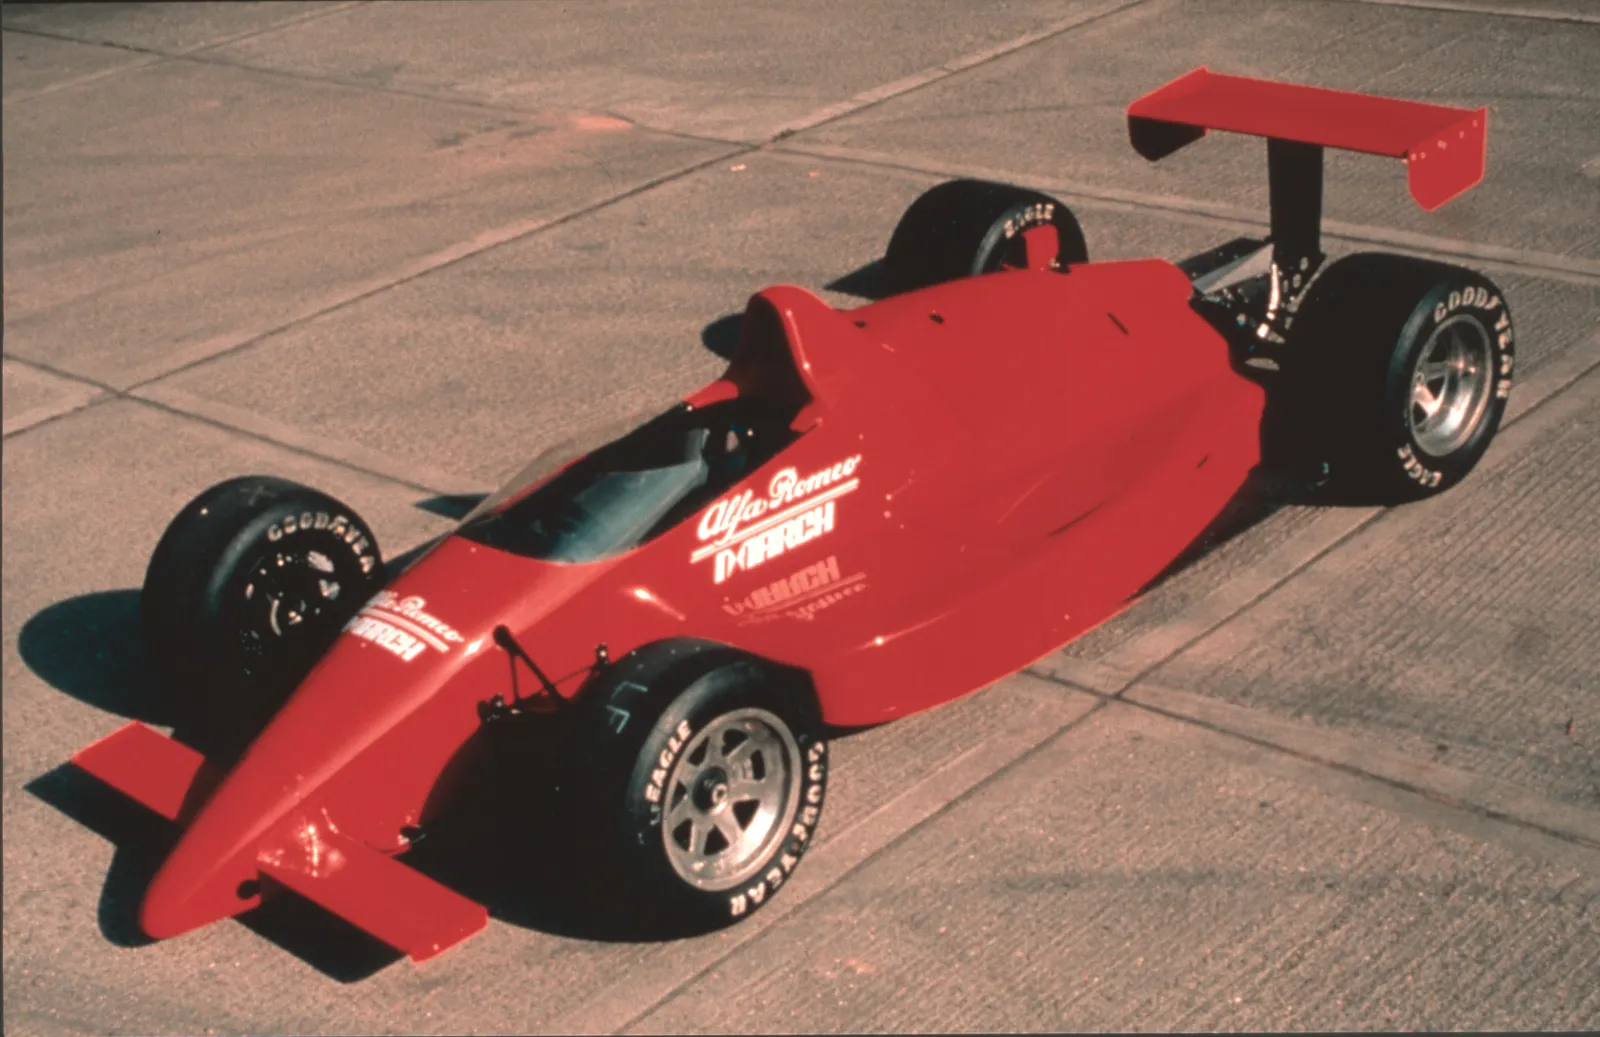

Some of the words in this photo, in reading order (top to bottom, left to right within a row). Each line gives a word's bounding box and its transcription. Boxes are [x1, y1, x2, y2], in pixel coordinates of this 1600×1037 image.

[697, 489, 768, 546] Alfa
[768, 454, 863, 509] Romeo
[267, 512, 375, 580] GOODYEA
[644, 720, 691, 801] EAGLE
